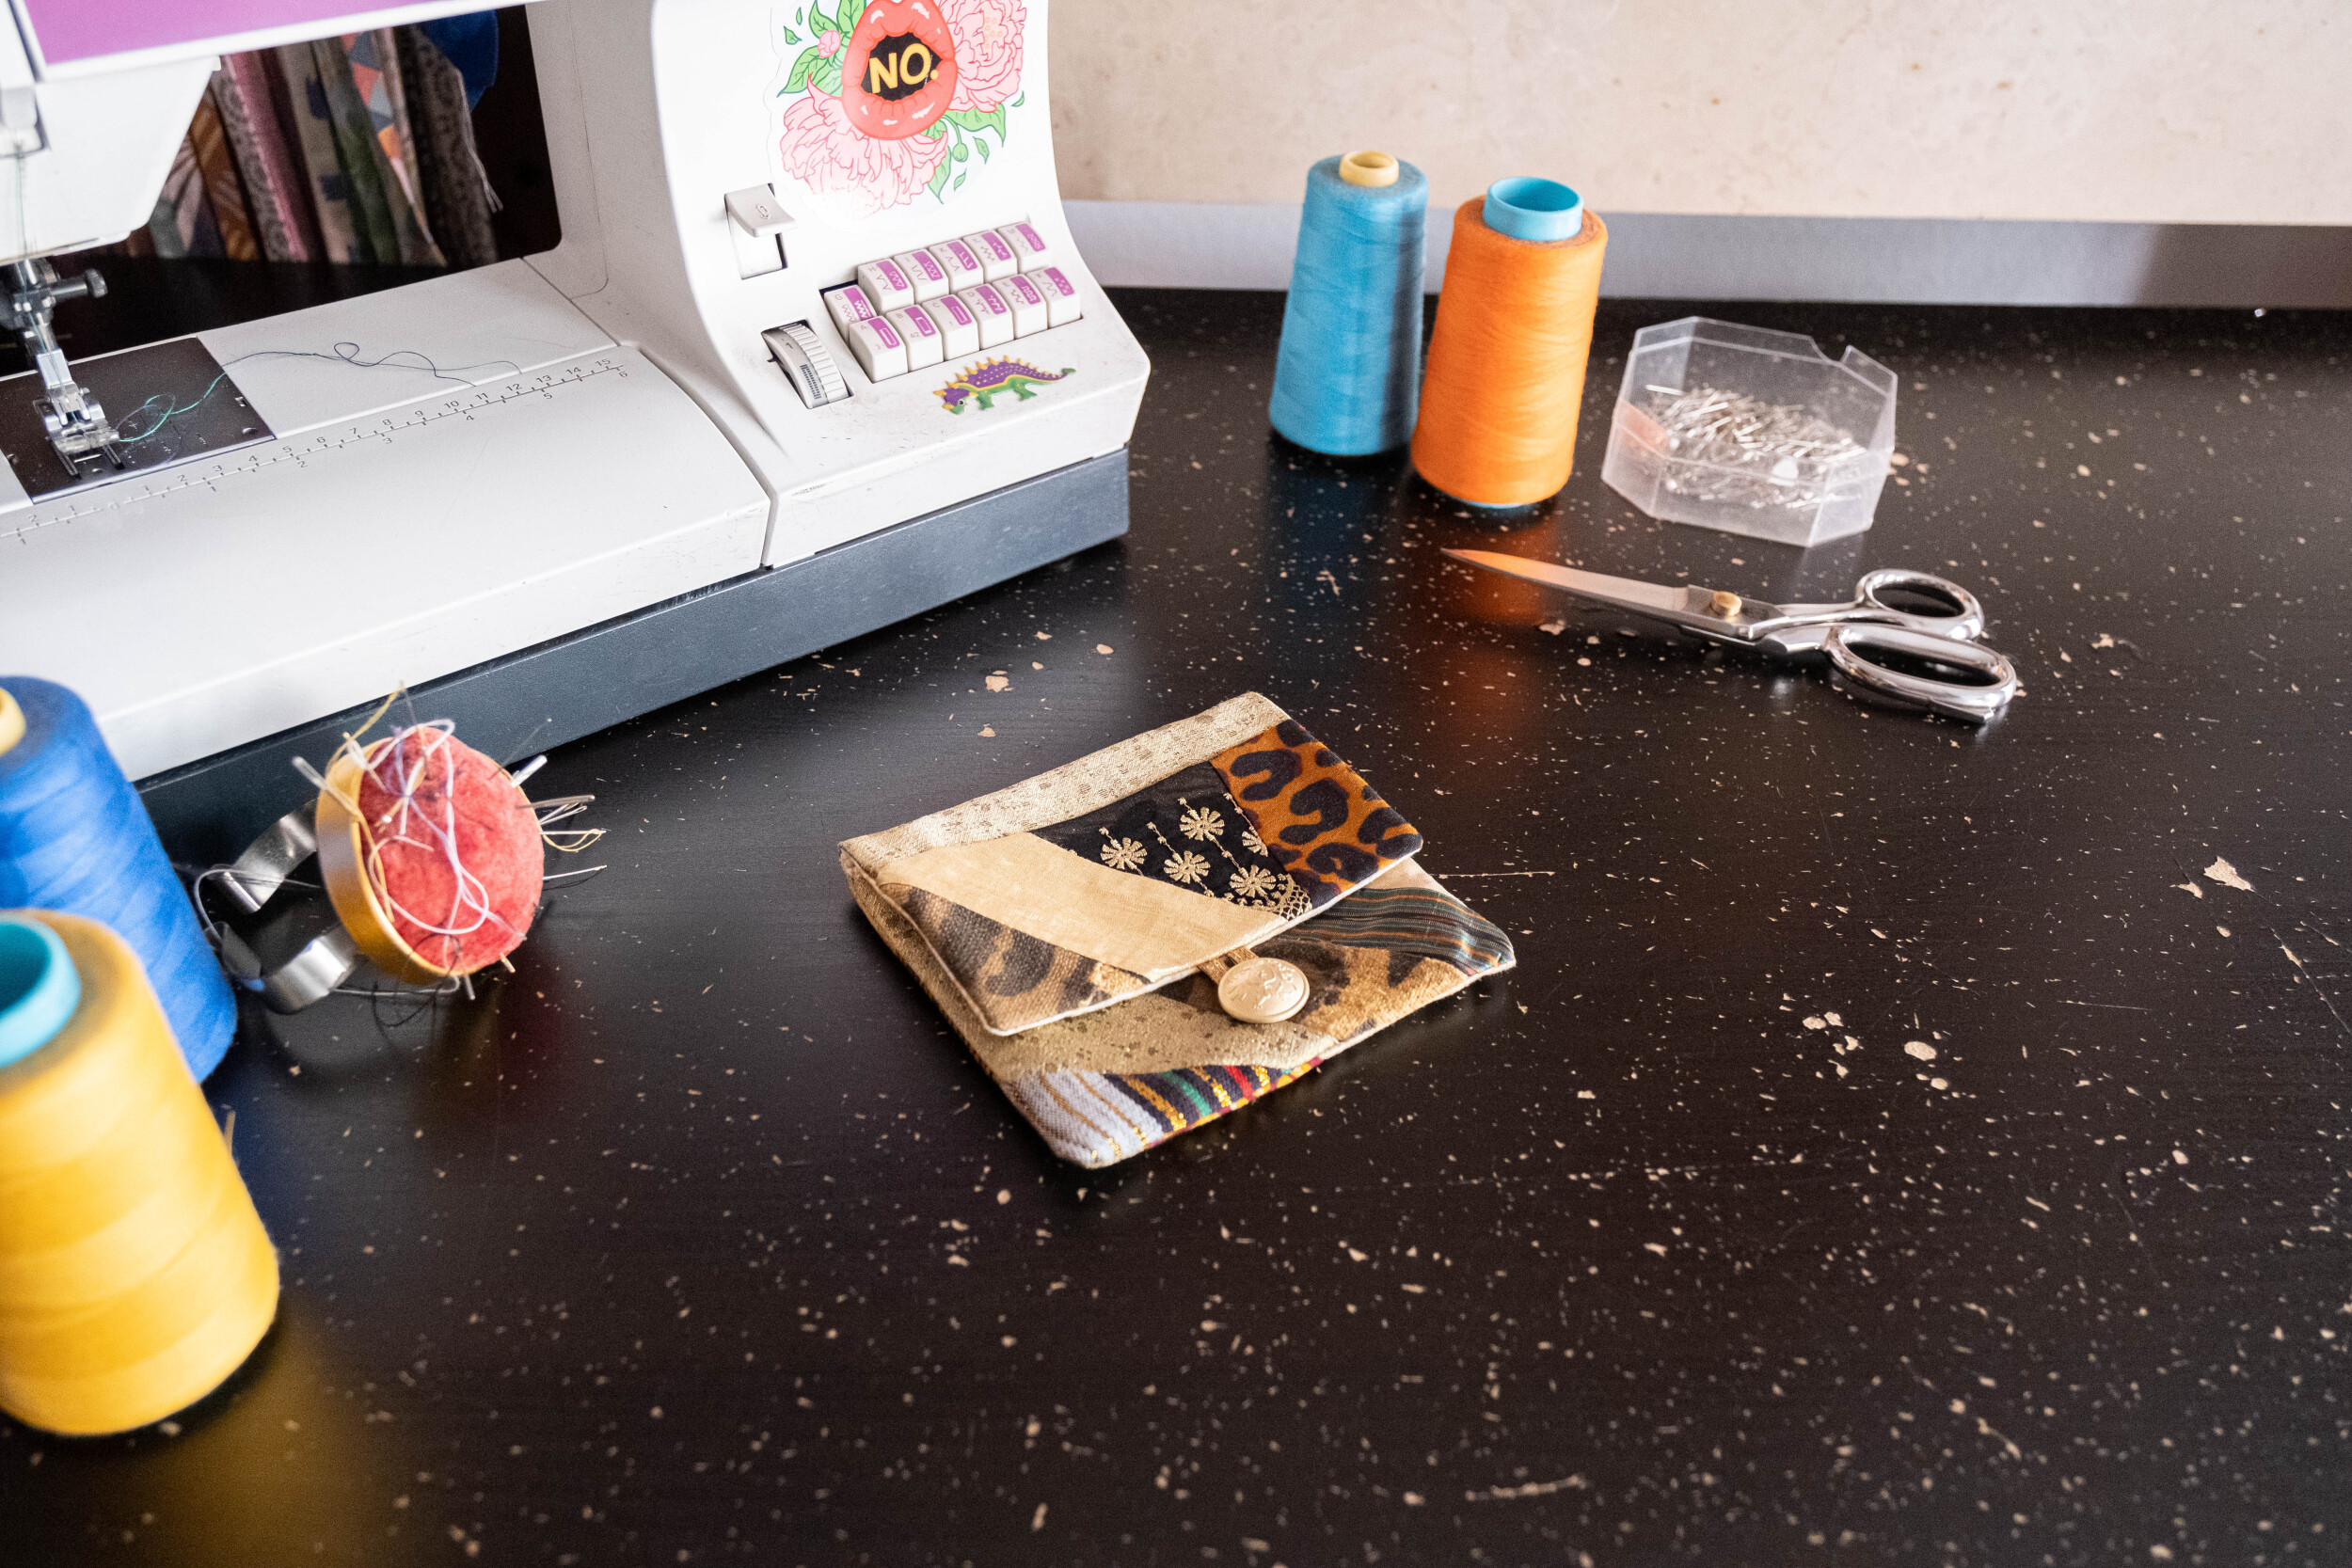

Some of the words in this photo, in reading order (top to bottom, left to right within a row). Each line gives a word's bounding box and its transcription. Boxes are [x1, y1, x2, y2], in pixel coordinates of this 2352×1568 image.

[869, 43, 938, 93] NO.
[28, 515, 37, 523] 2
[282, 445, 292, 453] 5
[443, 400, 460, 409] 10
[475, 392, 488, 401] 11
[505, 383, 522, 391] 12
[535, 374, 552, 383] 13
[565, 366, 581, 375] 14
[595, 357, 611, 367] 15
